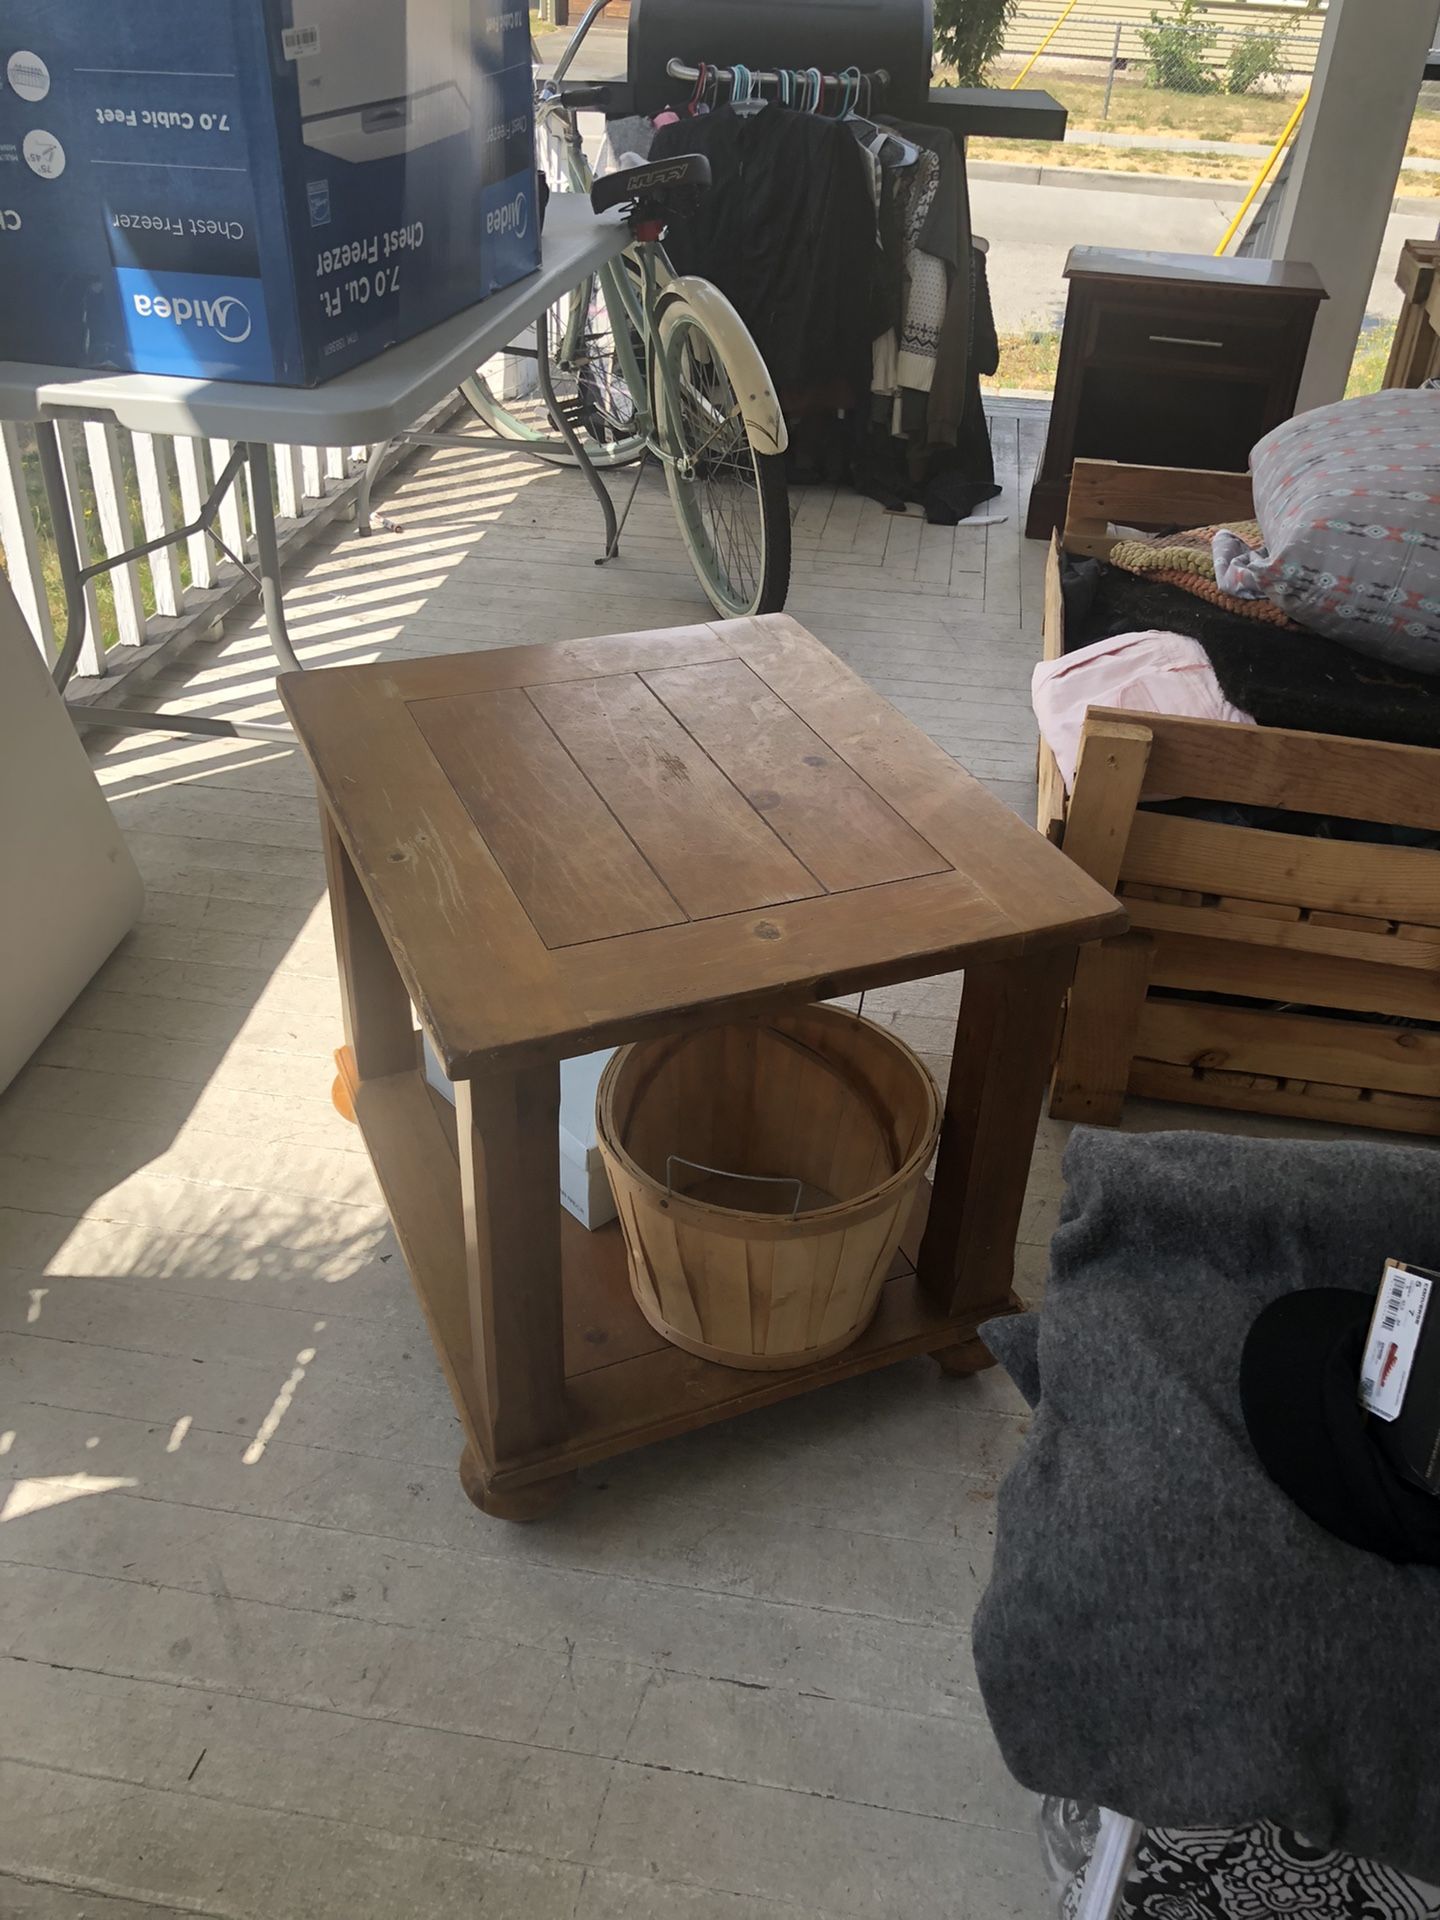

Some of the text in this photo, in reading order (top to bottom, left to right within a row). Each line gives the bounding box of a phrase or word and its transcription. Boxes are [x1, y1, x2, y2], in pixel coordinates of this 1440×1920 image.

[95, 108, 230, 131] 7.0 Cubic Feet
[627, 164, 688, 191] HUFFY
[113, 214, 244, 240] Chest Freezer
[486, 192, 527, 238] Midea
[316, 221, 424, 277] Chest Freezer
[320, 265, 401, 317] 7.0 Cu. Ft.
[133, 294, 246, 338] Midea
